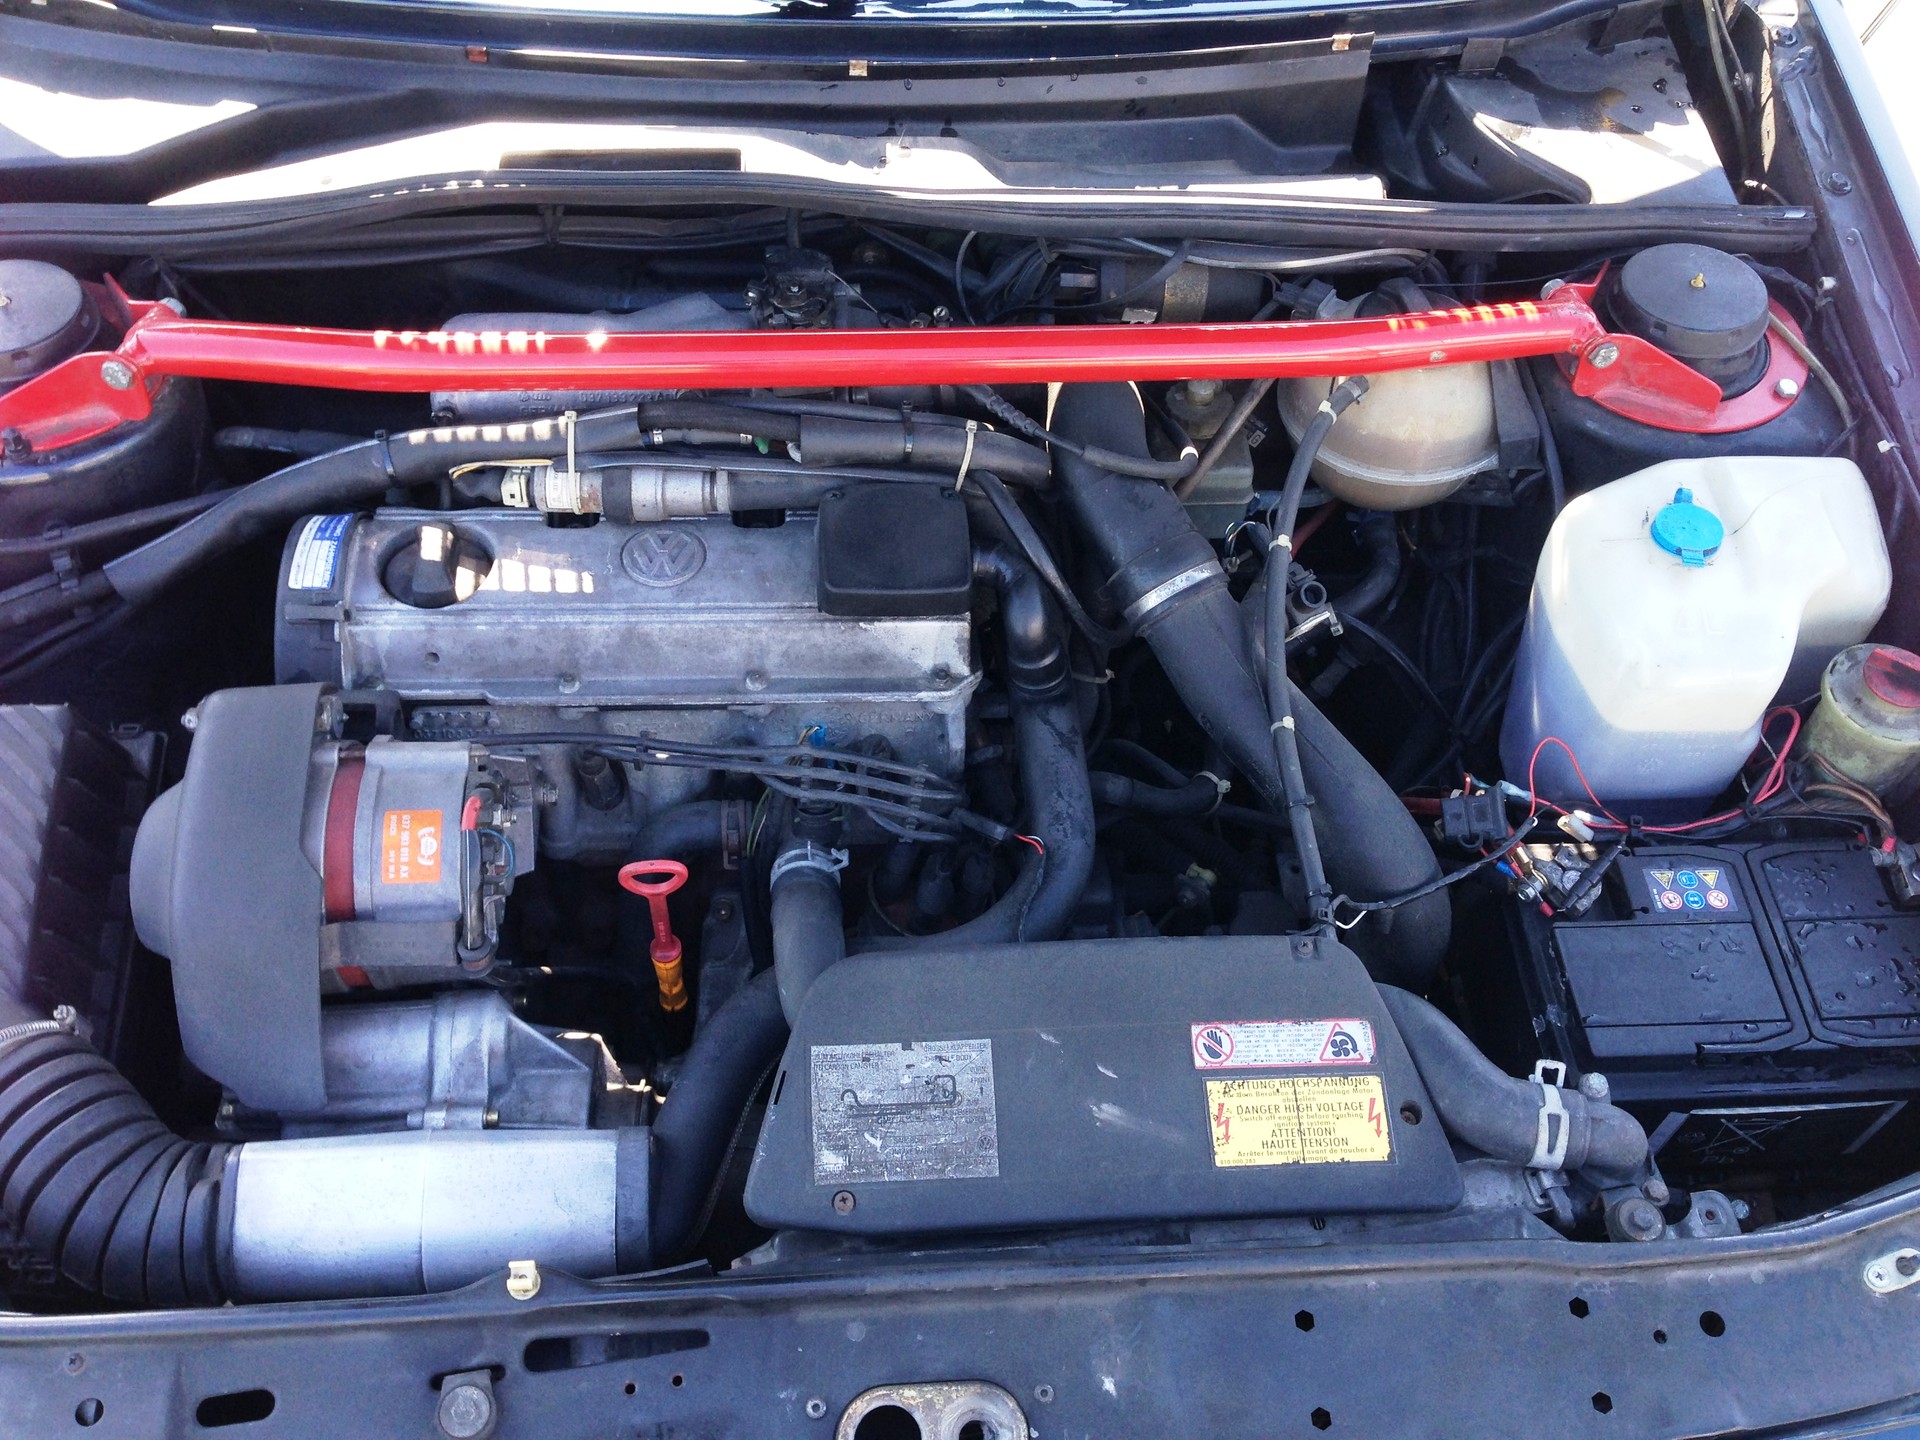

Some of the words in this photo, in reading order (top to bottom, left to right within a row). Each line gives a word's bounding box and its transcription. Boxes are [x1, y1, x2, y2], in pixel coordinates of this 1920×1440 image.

[625, 528, 702, 582] VW
[400, 864, 409, 878] AX
[1224, 1080, 1276, 1092] ACHTUNG
[1282, 1095, 1317, 1104] absellen
[1236, 1104, 1281, 1116] DANGER
[1284, 1102, 1312, 1114] HIGH
[1316, 1101, 1365, 1113] VOLTAGE
[1271, 1126, 1336, 1138] ATTENTION!
[1261, 1138, 1297, 1149] HAUTE
[1303, 1137, 1349, 1148] TENSION
[1329, 1146, 1338, 1154] de
[1340, 1146, 1367, 1154] toucher
